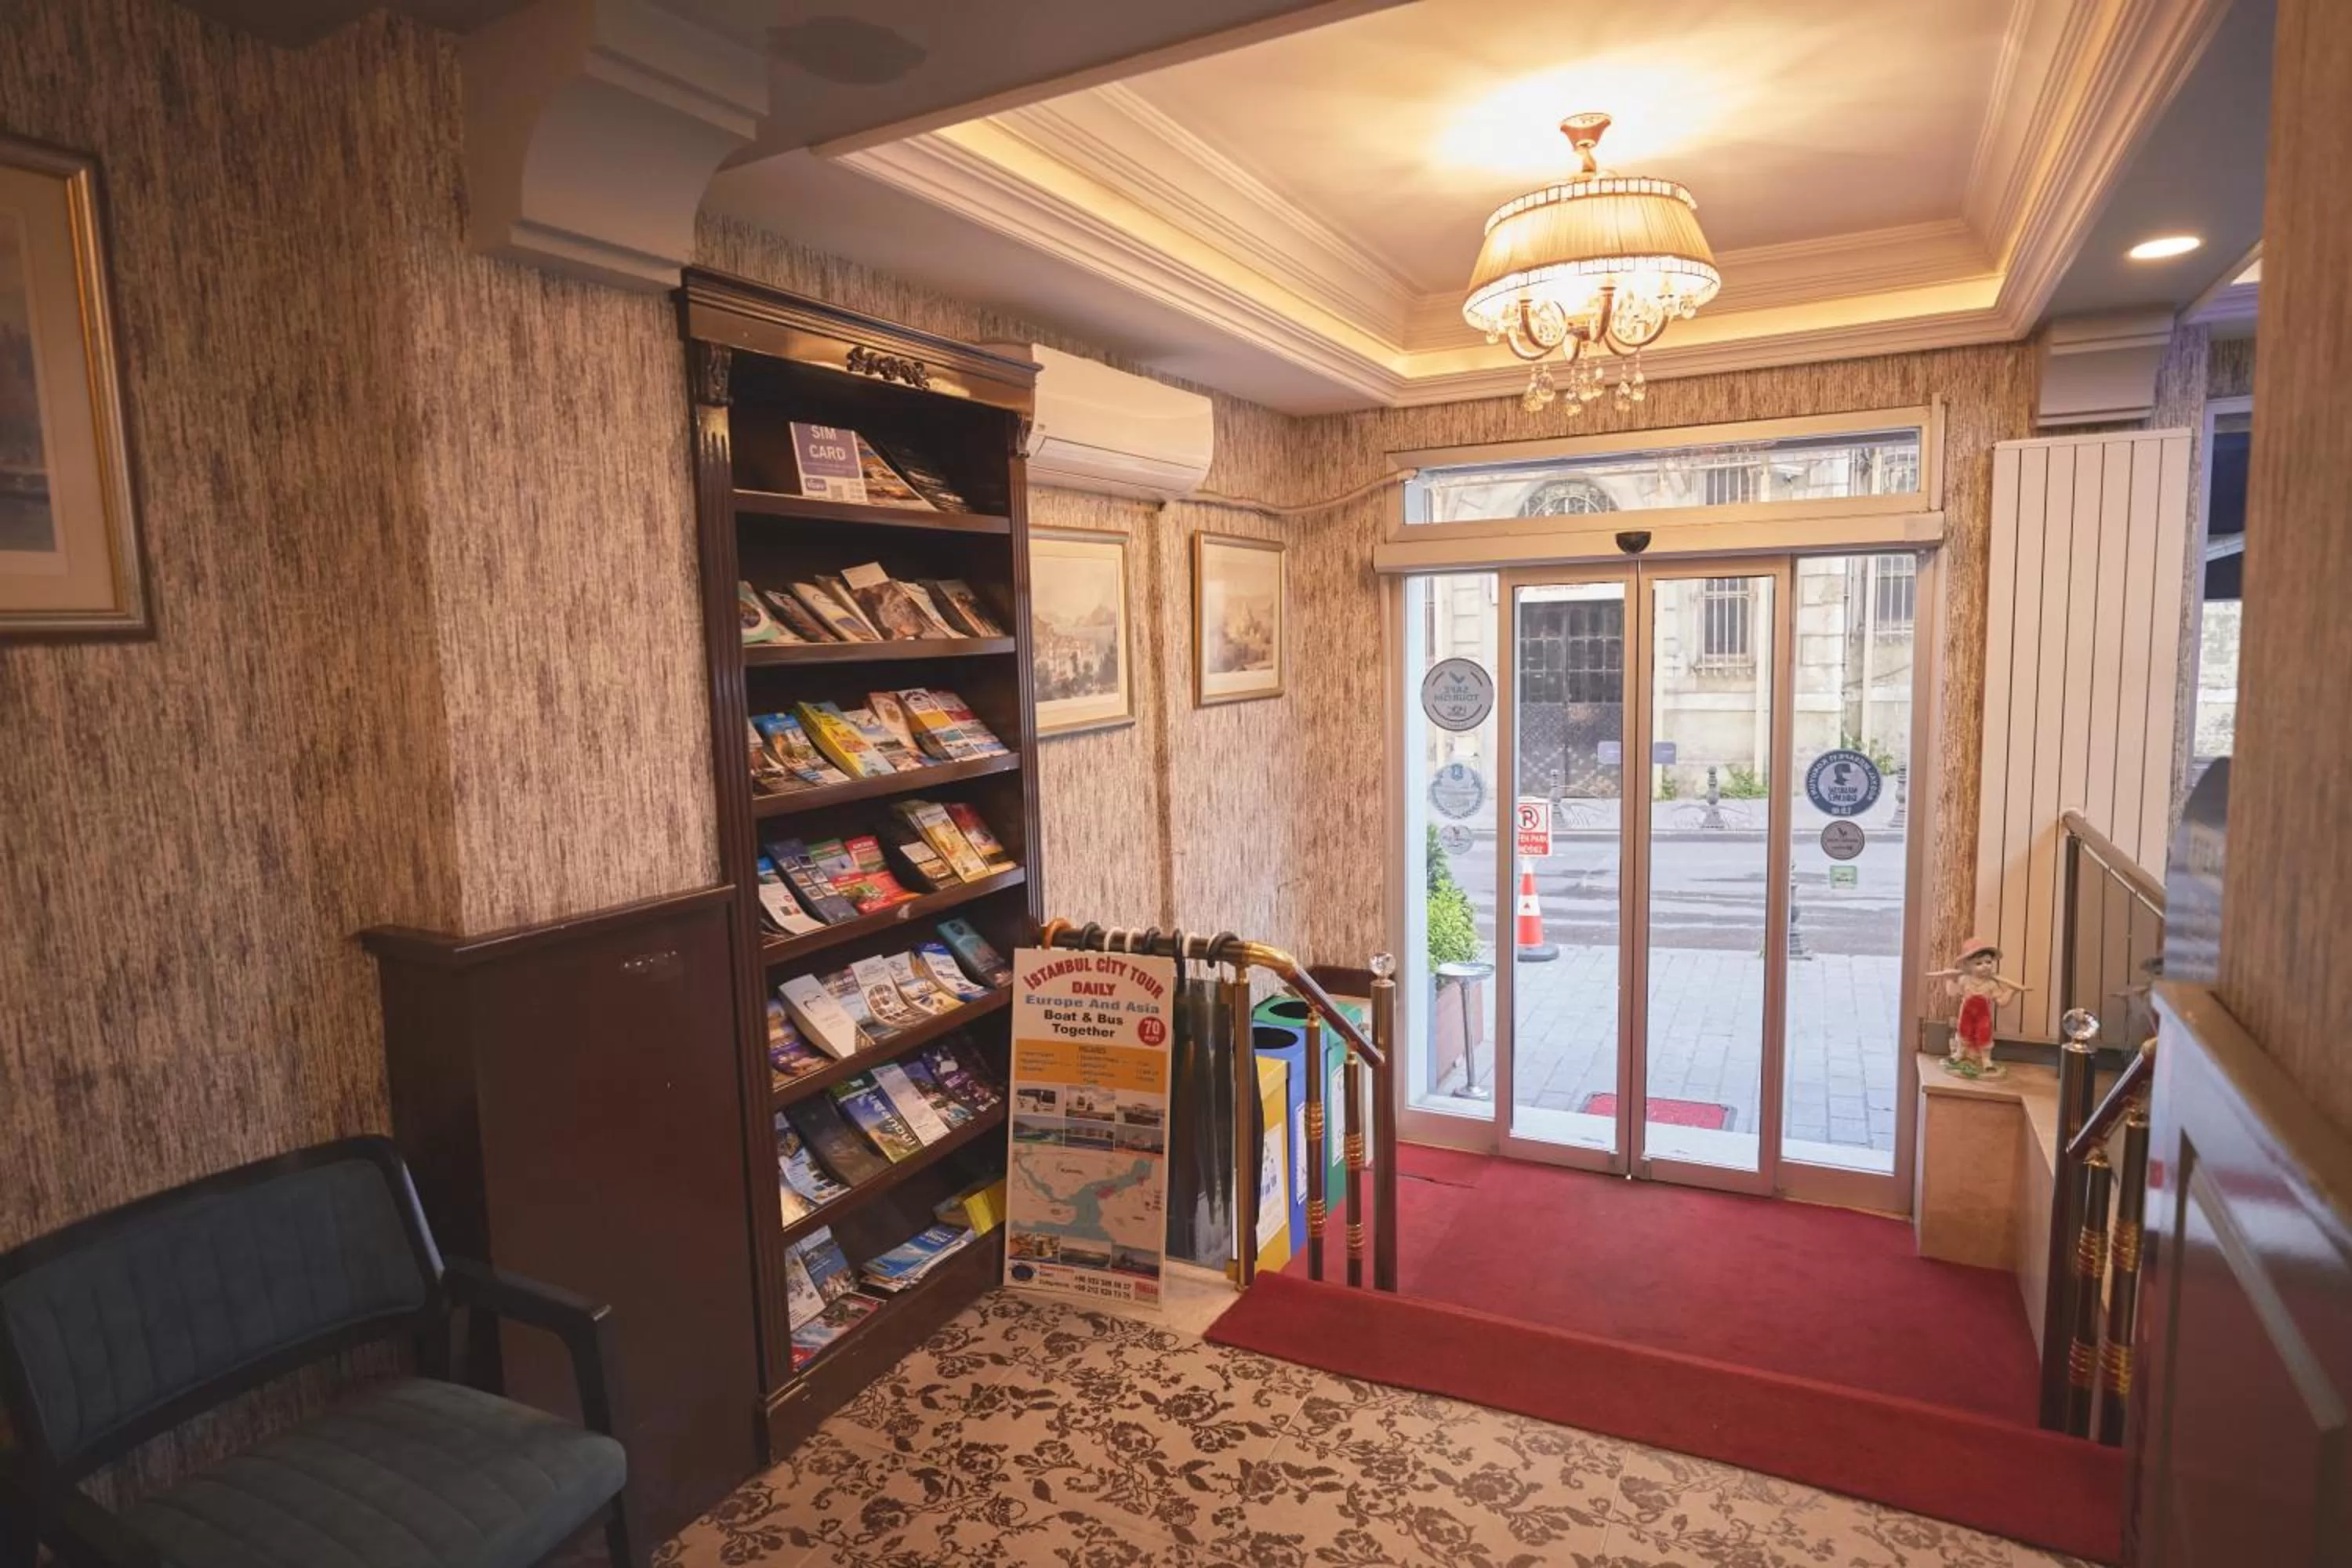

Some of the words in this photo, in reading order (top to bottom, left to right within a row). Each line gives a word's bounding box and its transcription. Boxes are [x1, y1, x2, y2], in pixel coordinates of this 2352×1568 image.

[811, 424, 837, 441] SIM
[808, 444, 847, 461] CARD
[1072, 981, 1116, 996] DAILY
[1130, 965, 1164, 1000] TOUR
[1025, 995, 1083, 1008] Europe
[1089, 999, 1120, 1011] And
[1126, 1002, 1160, 1014] Asia
[1044, 1009, 1076, 1022] Boat
[1082, 1012, 1092, 1022] &
[1098, 1014, 1123, 1025] Bus
[1052, 1023, 1115, 1038] Together
[1144, 1020, 1160, 1034] 70
